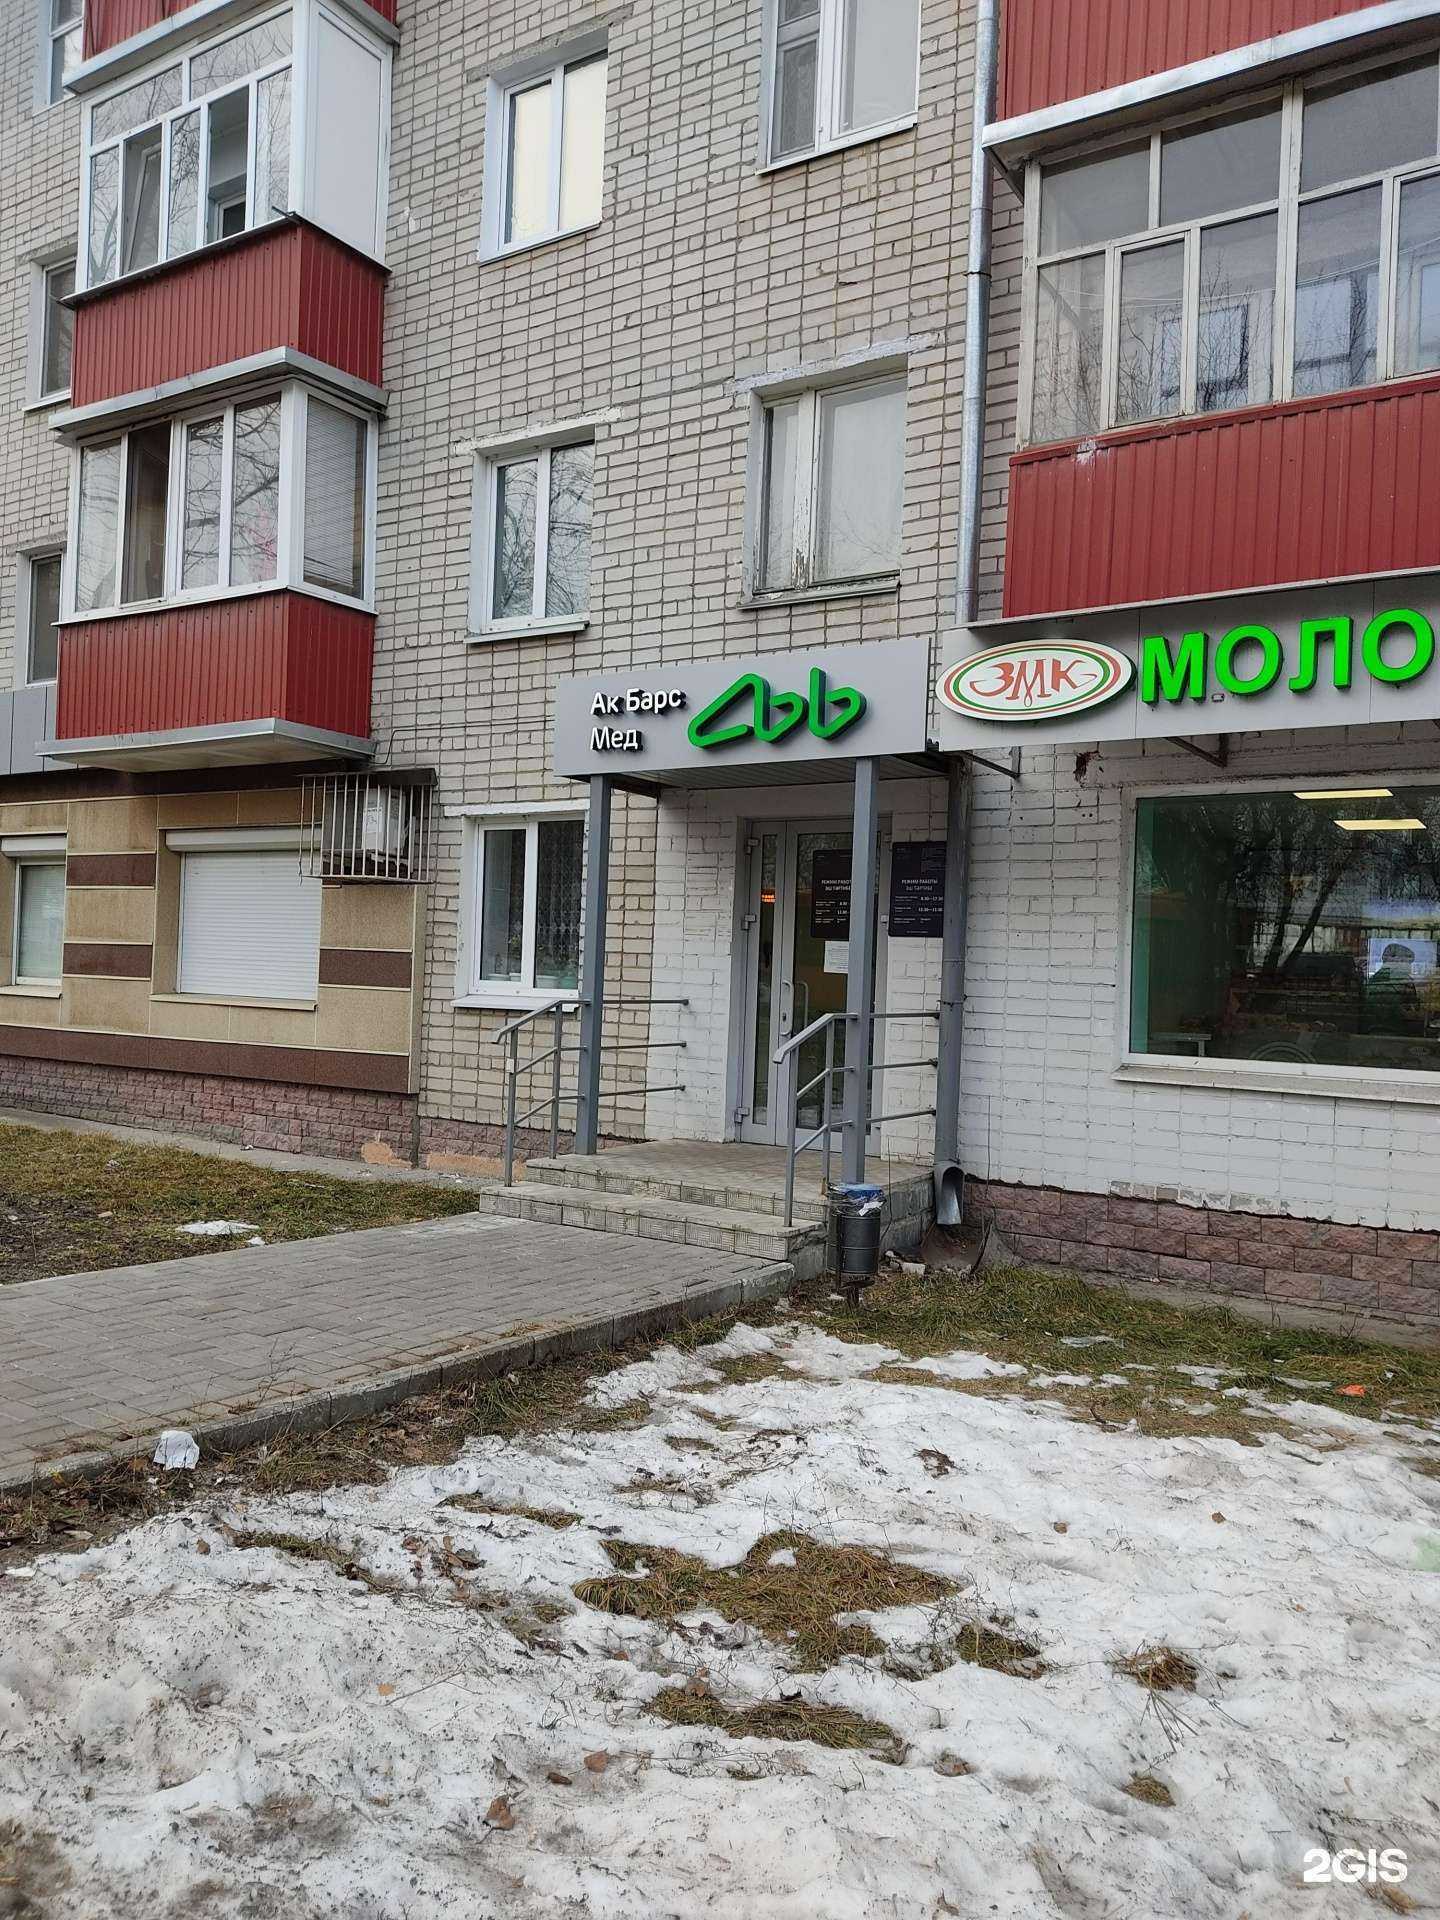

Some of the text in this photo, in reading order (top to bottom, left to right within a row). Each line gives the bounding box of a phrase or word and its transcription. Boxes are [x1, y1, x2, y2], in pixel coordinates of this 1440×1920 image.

[1142, 608, 1436, 704] МОЛО
[590, 687, 684, 715] Ак Барс
[969, 658, 1098, 708] ЗМК
[590, 725, 641, 751] Мед
